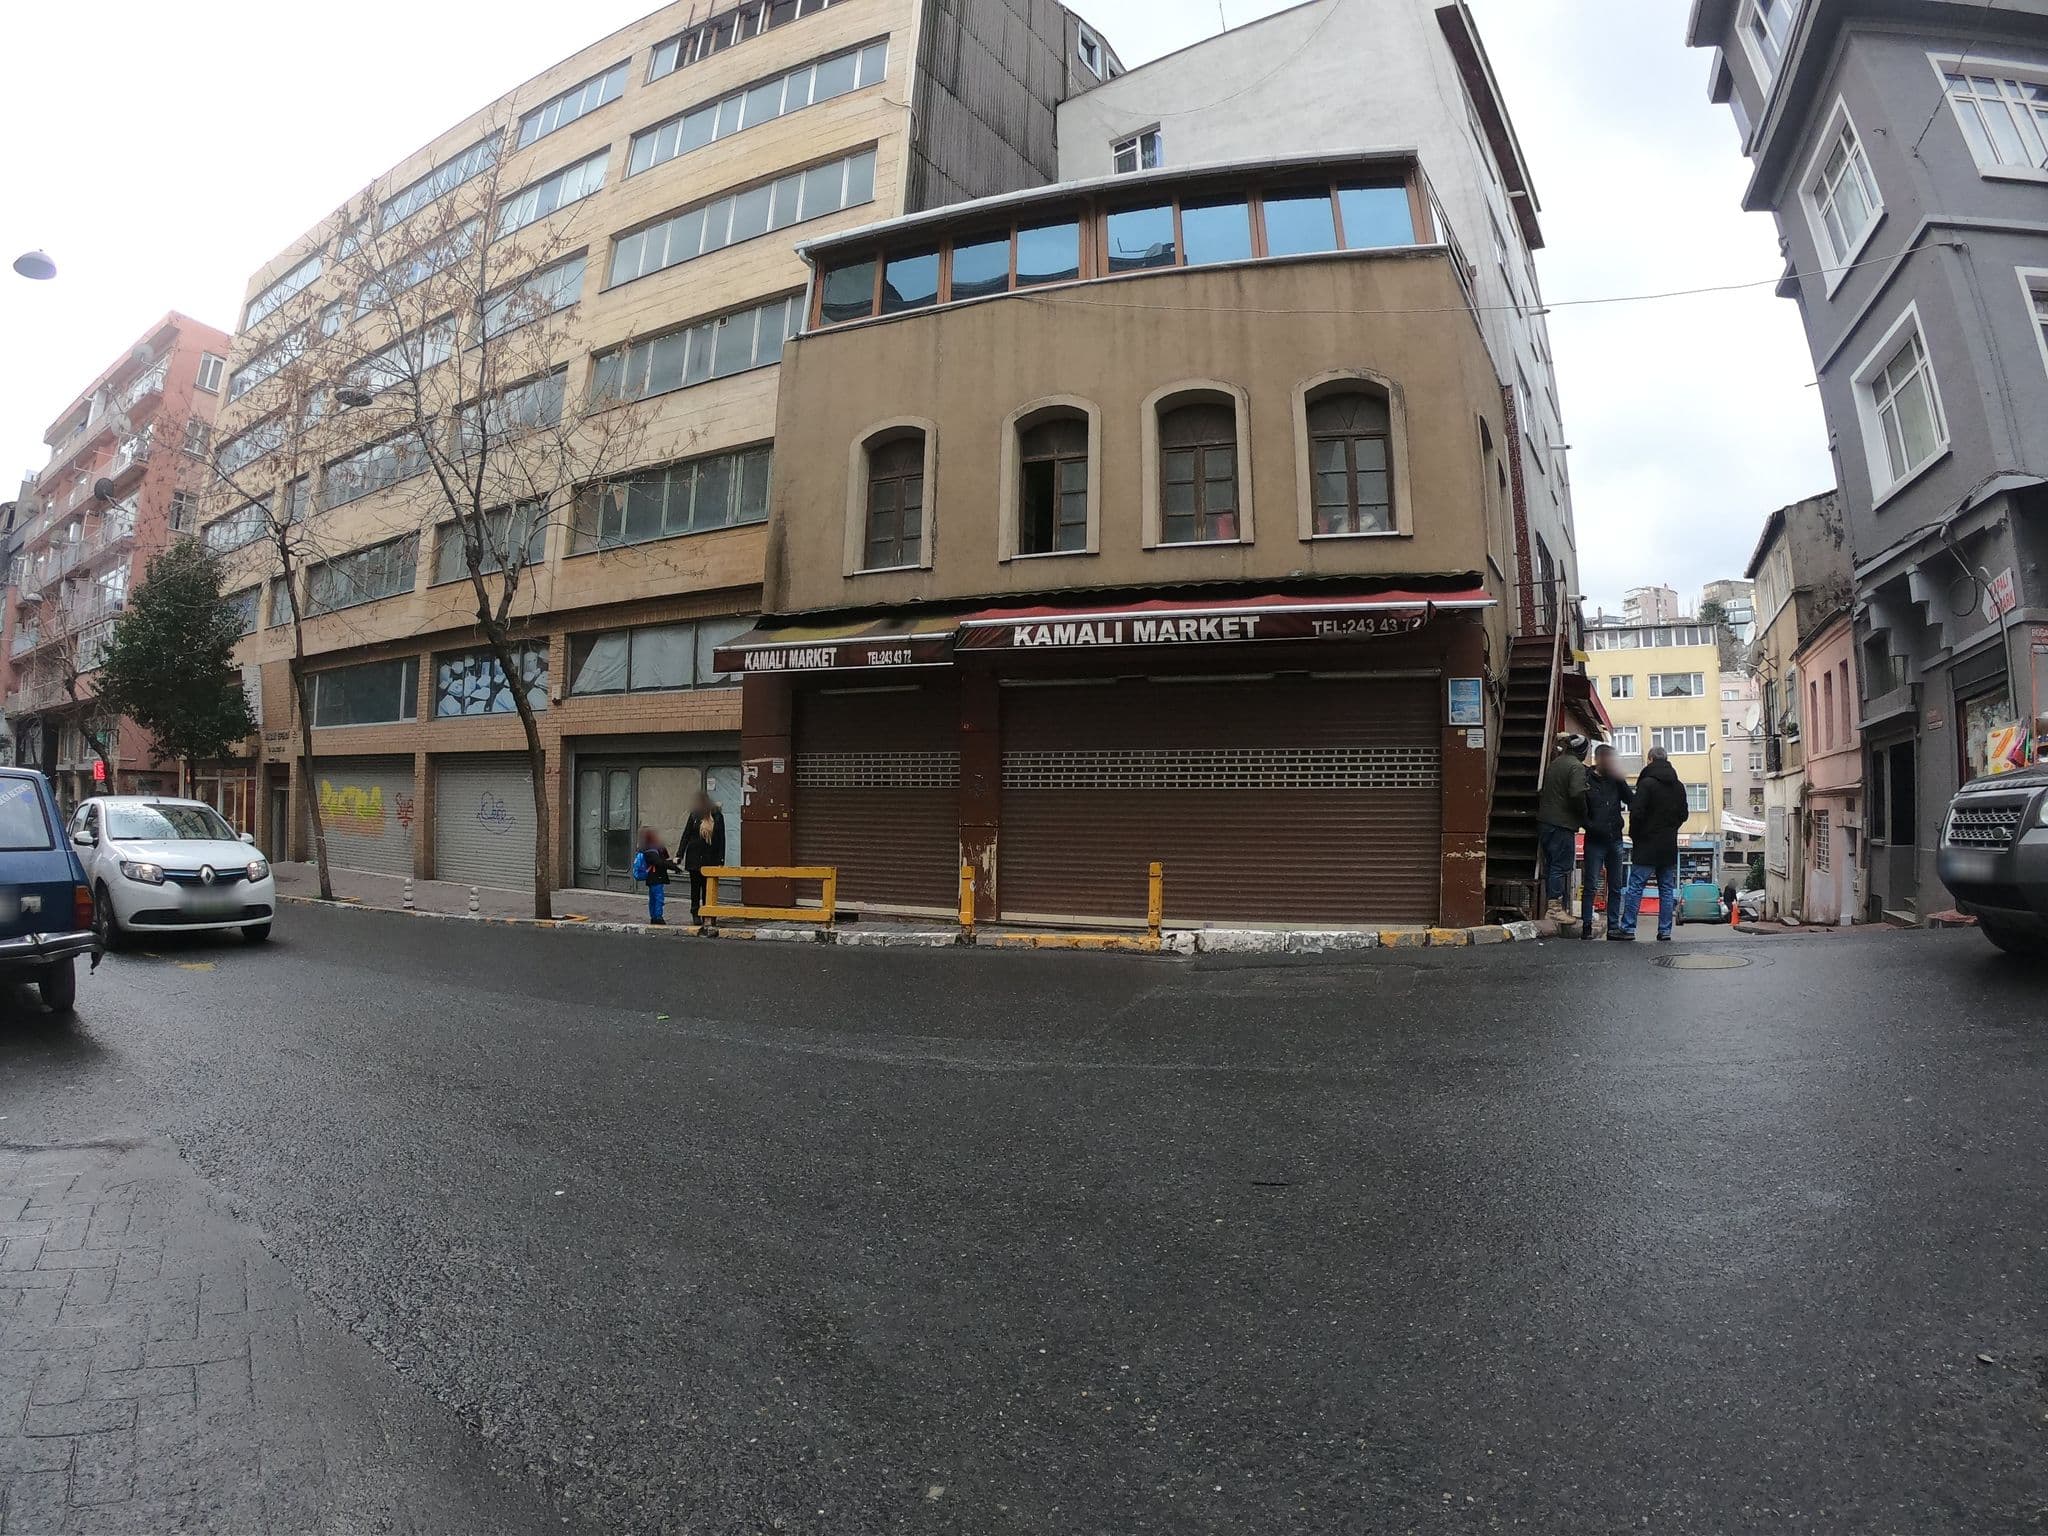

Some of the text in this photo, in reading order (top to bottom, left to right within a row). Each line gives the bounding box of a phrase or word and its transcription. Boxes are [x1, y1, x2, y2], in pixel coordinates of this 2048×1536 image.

[1013, 620, 1123, 646] KAMALI
[1133, 616, 1260, 642] MARKET
[1311, 618, 1375, 636] TEL:243
[1379, 618, 1398, 632] 43
[744, 647, 912, 671] KAMALI MARKET TEL:243 43 72
